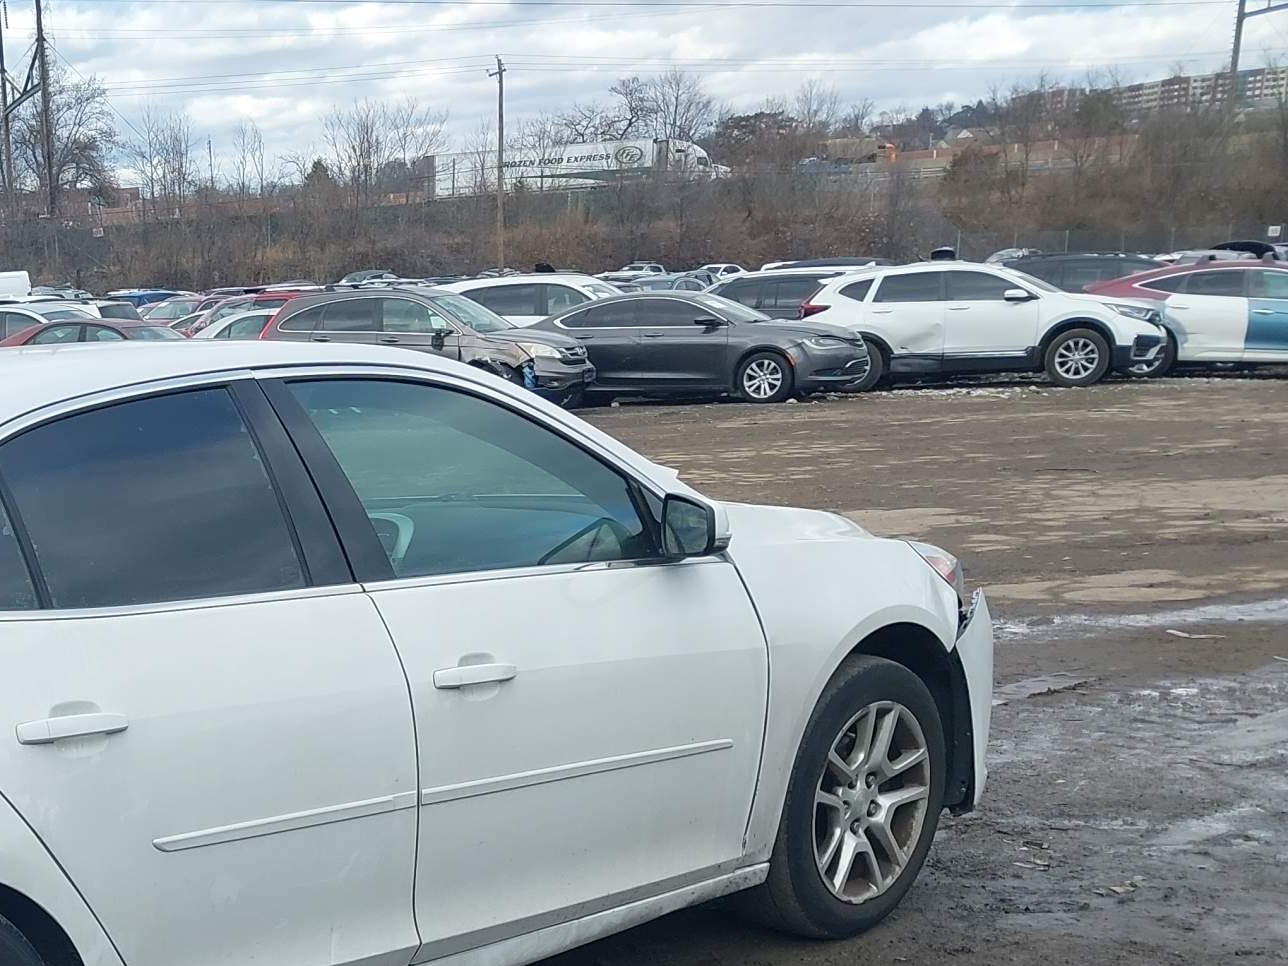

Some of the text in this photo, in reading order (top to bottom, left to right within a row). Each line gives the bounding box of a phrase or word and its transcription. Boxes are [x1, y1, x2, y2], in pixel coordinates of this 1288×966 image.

[501, 152, 611, 168] ROZEN FOOD EXPRESS
